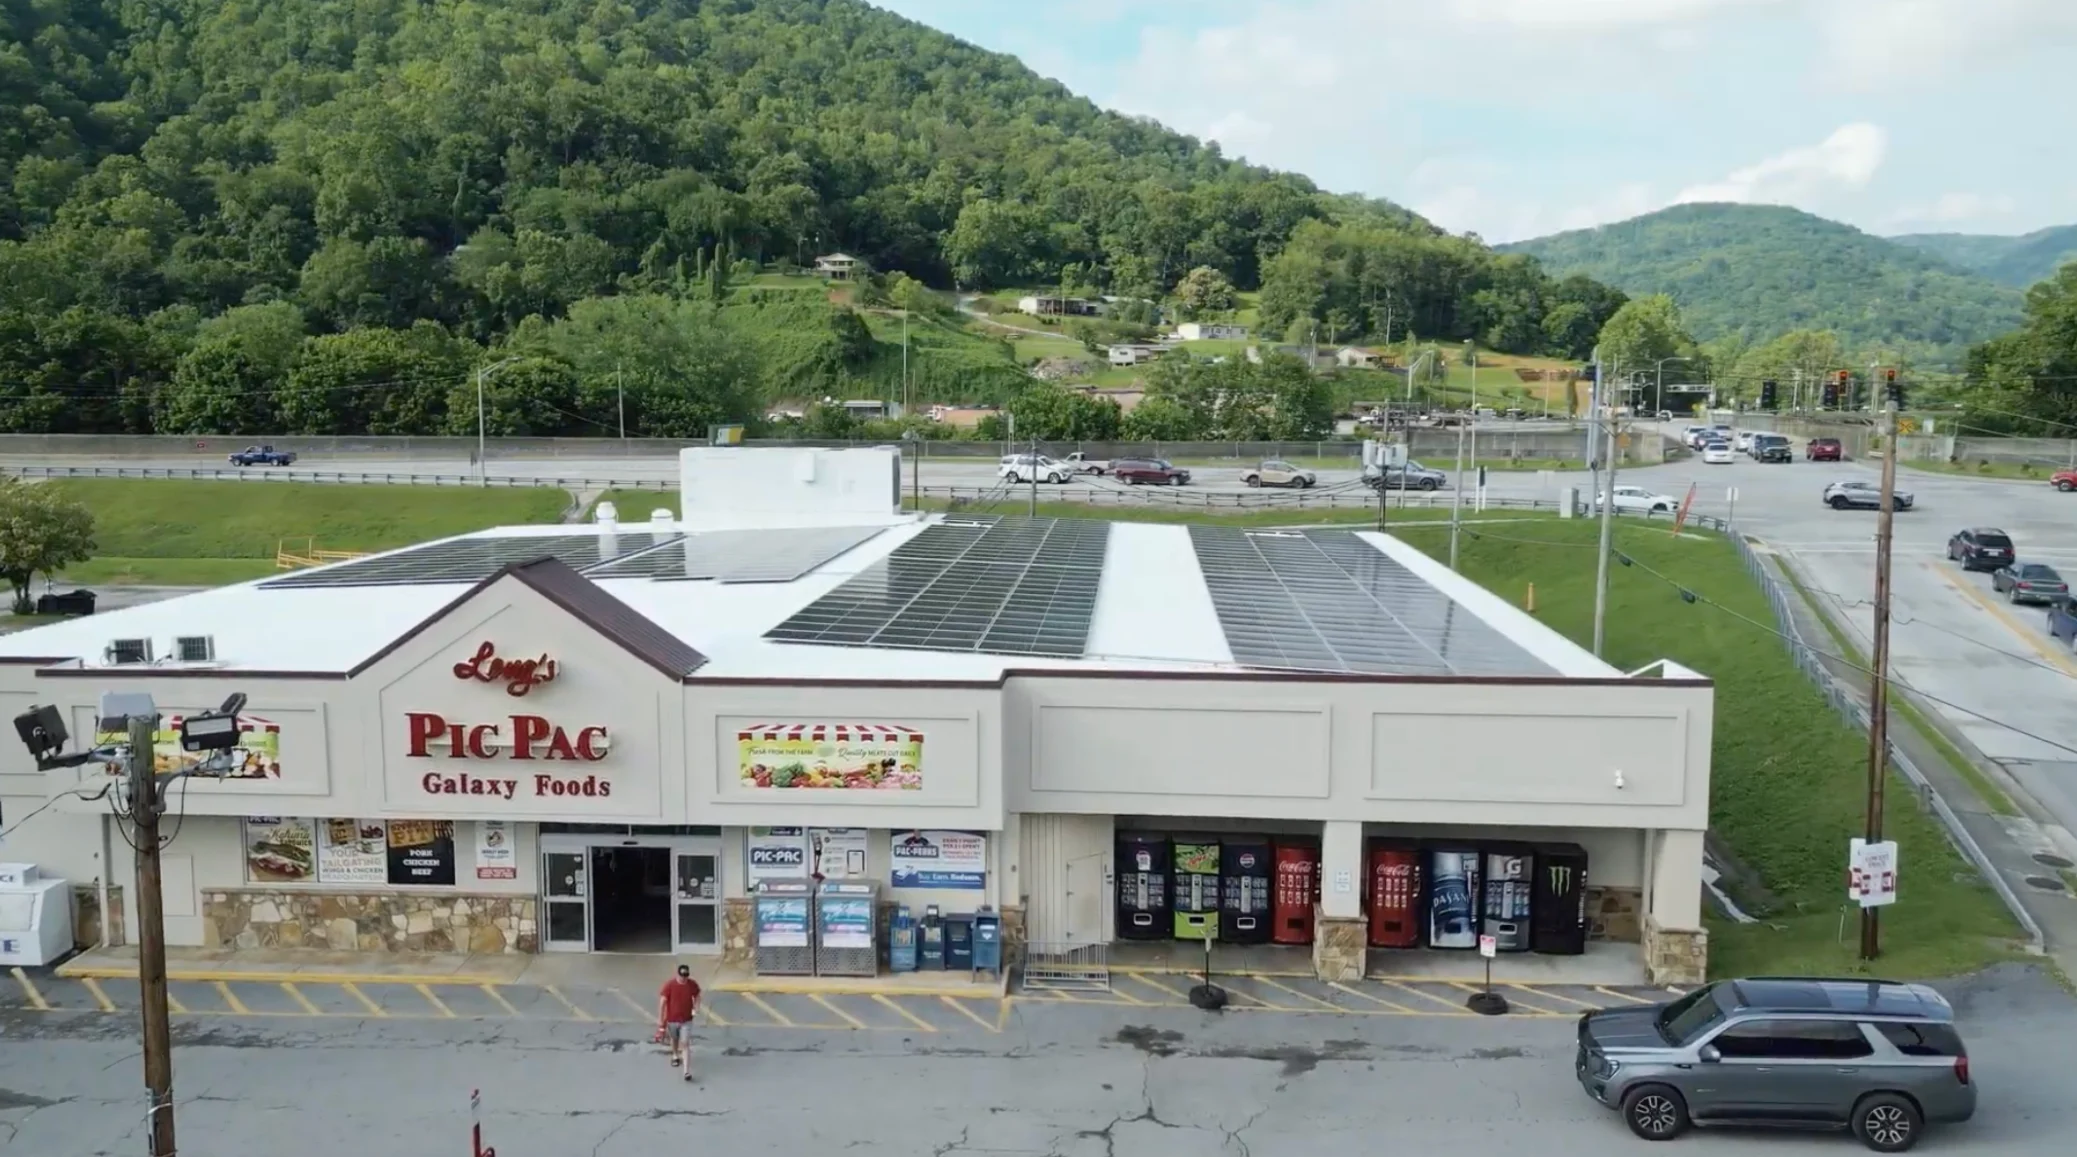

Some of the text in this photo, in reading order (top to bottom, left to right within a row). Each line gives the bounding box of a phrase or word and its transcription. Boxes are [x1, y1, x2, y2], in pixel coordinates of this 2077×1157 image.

[453, 641, 561, 697] Long's
[404, 712, 609, 761] PIC PAC
[423, 772, 611, 800] Galaxy Foods
[409, 849, 434, 857] PORK
[753, 850, 801, 863] PIC-PAC
[896, 846, 937, 857] PAC-PERKS
[403, 859, 441, 867] CHICKEN
[411, 868, 433, 876] BEEF
